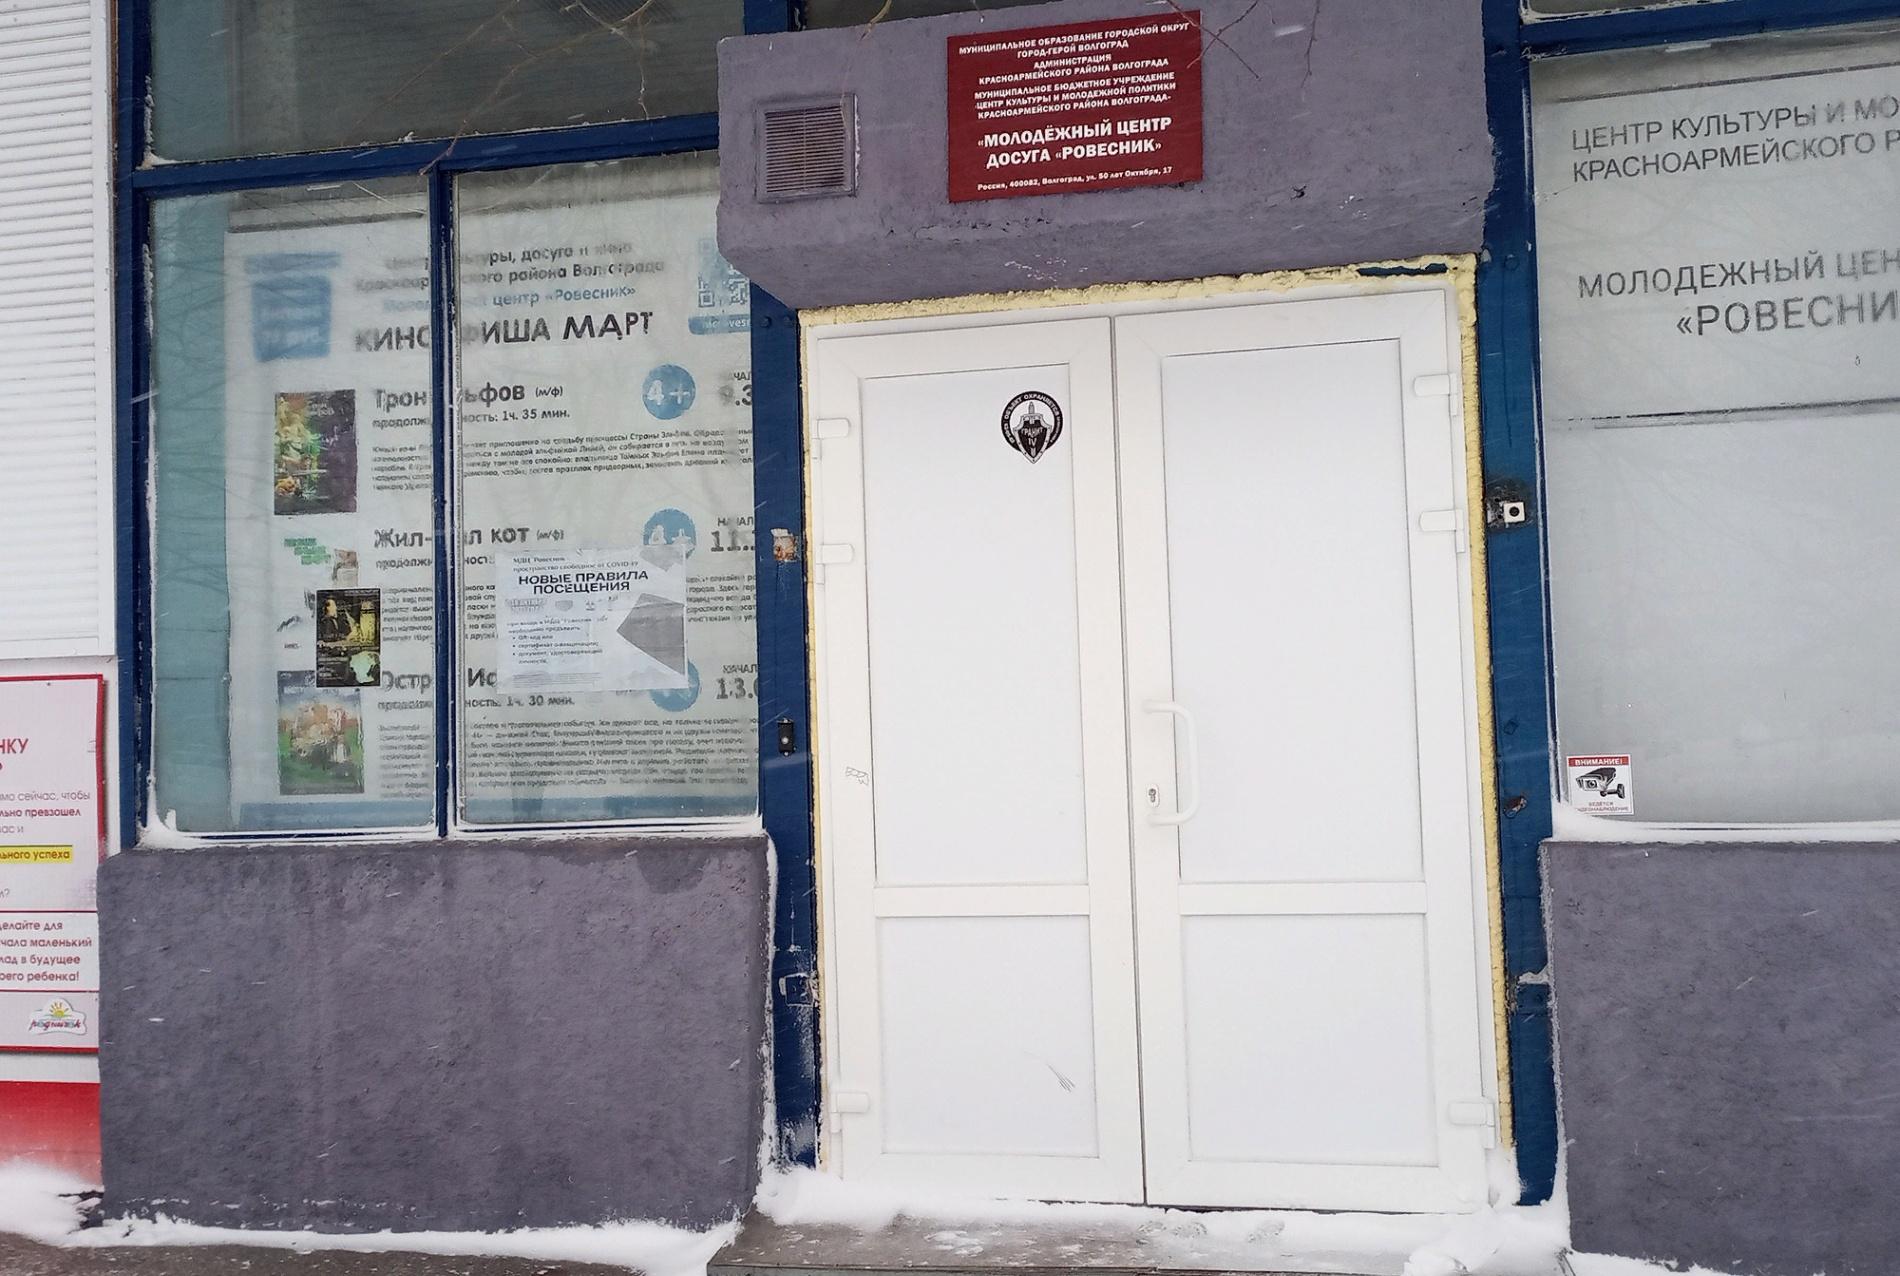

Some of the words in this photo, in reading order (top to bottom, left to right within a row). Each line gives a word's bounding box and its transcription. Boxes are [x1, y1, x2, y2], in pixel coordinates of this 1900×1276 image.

[959, 40, 1036, 54] МУНИЦИПАЛЬНОЕ
[1039, 32, 1102, 46] ОБРАЗОВАНИЕ
[1105, 25, 1158, 38] ГОРОДСКОЙ
[1161, 23, 1190, 33] ОКРУГ
[1017, 45, 1076, 58] ГОРОД-ГЕРОЙ
[1079, 40, 1128, 51] ВОЛГОГРАД
[1034, 54, 1111, 69] АДМИНИСТРАЦИЯ
[979, 68, 1071, 85] КРАСНОАРМЕЙСКОГО
[1074, 64, 1110, 75] РАЙОНА
[1113, 58, 1168, 71] ВОЛГОГРАДА
[975, 85, 1052, 99] МУНИЦИПАЛЬНОЕ
[1055, 78, 1111, 92] БЮДЖЕТНОЕ
[1114, 72, 1174, 86] УЧРЕЖДЕНИЕ
[1006, 95, 1051, 107] КУЛЬТУРЫ
[1128, 82, 1175, 94] ПОЛИТИКИ
[978, 103, 1070, 119] КРАСНОАРМЕЙСКОГО
[1073, 98, 1109, 110] РАЙОНА
[978, 119, 1112, 148] «МОЛОДЁЖНЫЙ
[1117, 117, 1172, 135] ЦЕНТР
[1572, 120, 1663, 153] ЦЕНТР
[1672, 105, 1816, 140] КУЛЬТУРЫ
[1827, 103, 1844, 124] И
[986, 148, 1051, 169] ДОСУГА
[1056, 139, 1161, 159] «РОВЕСНИК»
[1573, 132, 1875, 182] КРАСНОАРМЕЙСКОГО
[978, 182, 1007, 191] Россия,
[1043, 174, 1084, 186] Волгоград,
[1086, 173, 1096, 182] ул.
[1125, 167, 1161, 178] Октября,
[509, 264, 566, 282] района
[1579, 251, 1824, 298] МОЛОДЕЖНЫЙ
[492, 292, 539, 306] центр
[562, 311, 653, 341] МАРТ
[374, 389, 427, 412] Трон
[535, 386, 563, 397] (м/ф)
[522, 409, 537, 419] 35
[541, 409, 570, 419] мин.
[518, 573, 572, 585] НОВЫЕ
[575, 571, 648, 583] ПРАВИЛА
[533, 581, 630, 595] ПОСЕЩЕНИЯ
[528, 695, 544, 706] 30
[1575, 758, 1623, 766] ВНИМАНИЕ!
[18, 791, 59, 802] сейчас,
[61, 790, 91, 801] чтобы
[25, 808, 81, 819] превзошел
[33, 850, 70, 861] успеха
[0, 921, 41, 931] елайте
[43, 922, 63, 931] для
[30, 937, 92, 948] маленький
[30, 955, 81, 968] будущее
[27, 971, 80, 984] ребенка!
